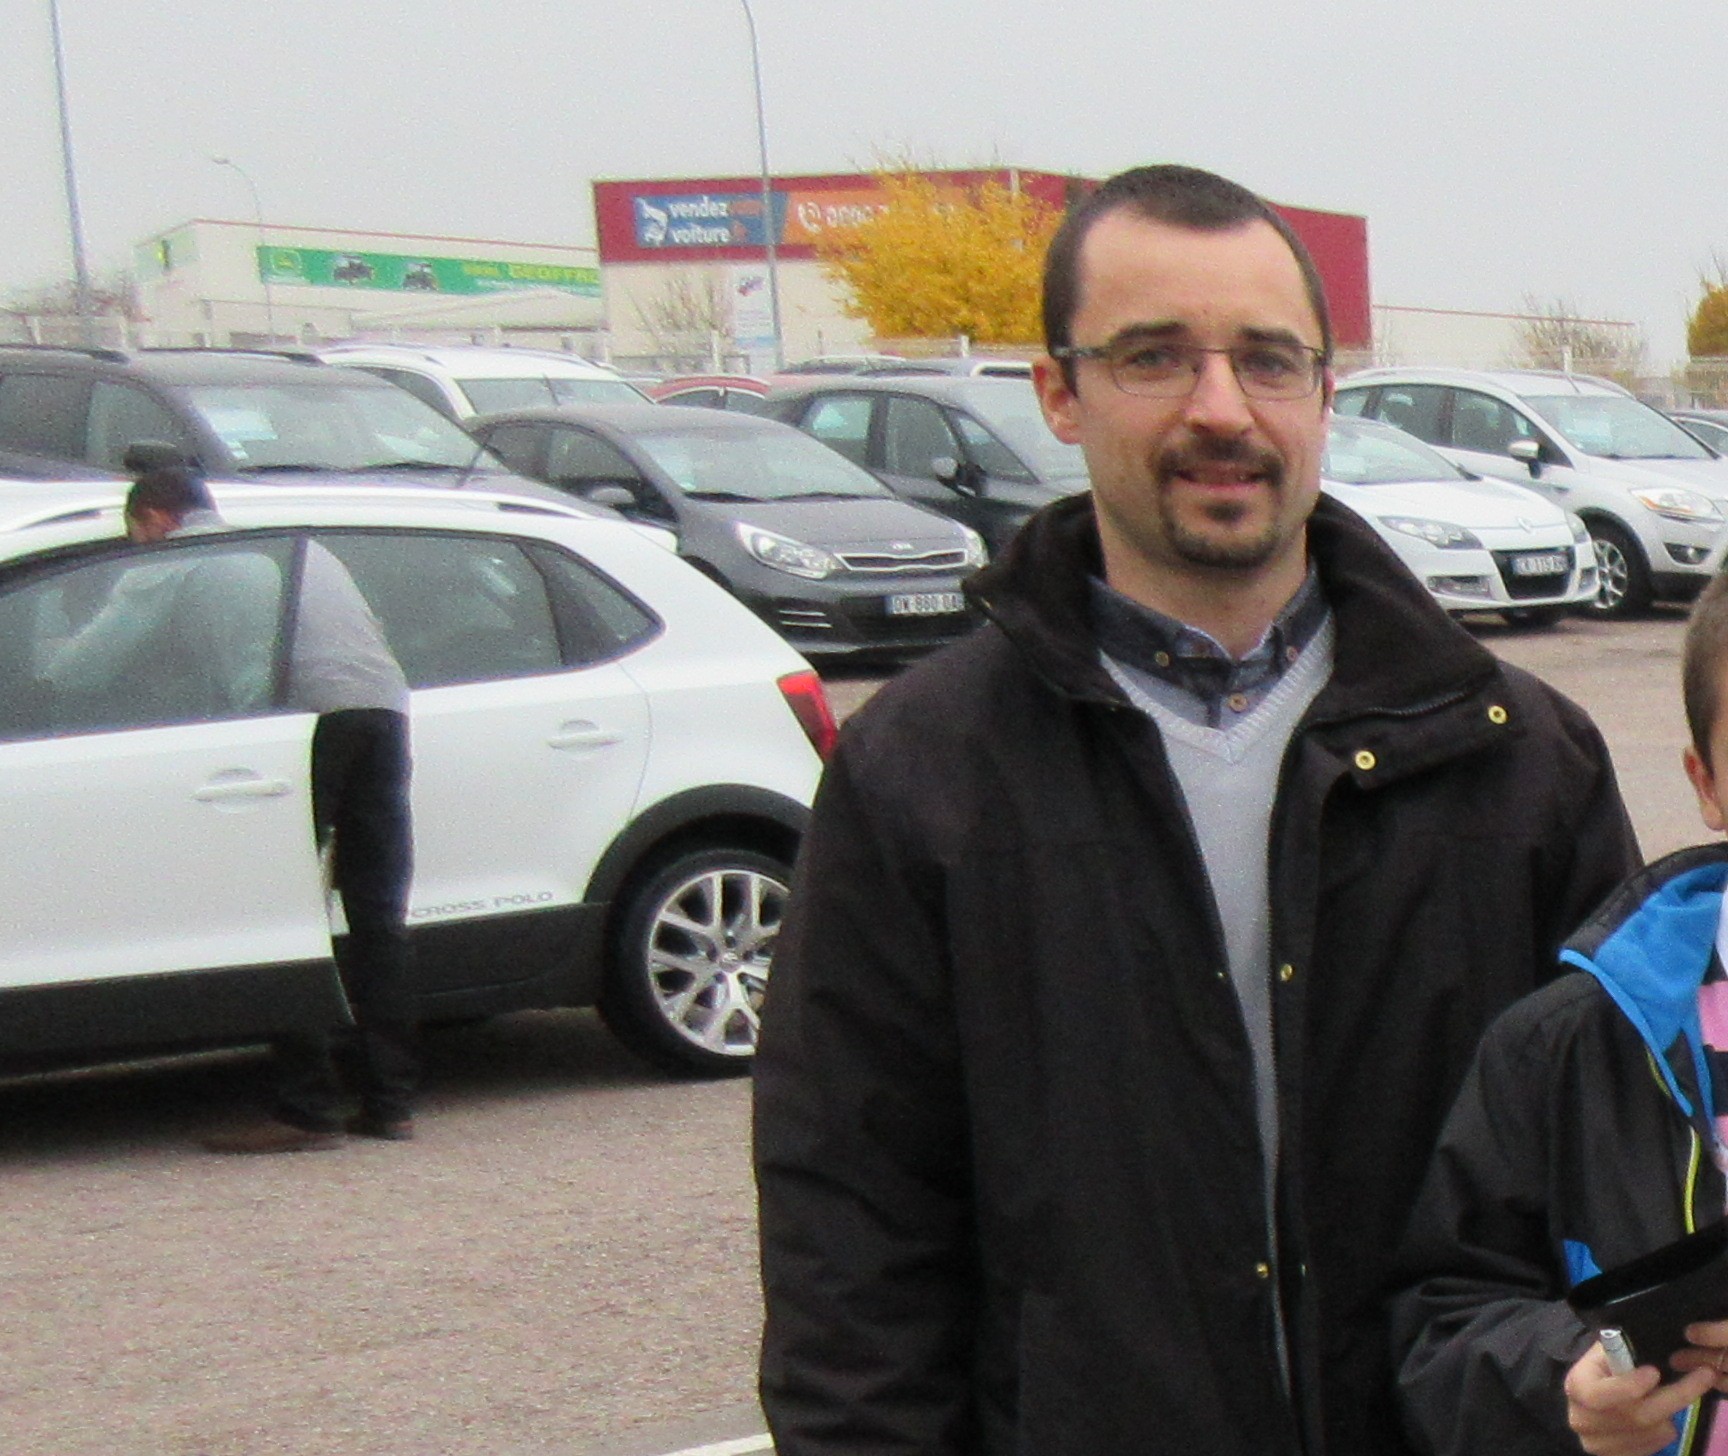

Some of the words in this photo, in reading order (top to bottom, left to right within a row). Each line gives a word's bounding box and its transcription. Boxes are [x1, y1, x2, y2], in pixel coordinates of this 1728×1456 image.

[669, 196, 729, 218] vendez
[672, 223, 730, 244] voiture
[411, 899, 486, 918] CROSS
[493, 890, 554, 907] POLO
